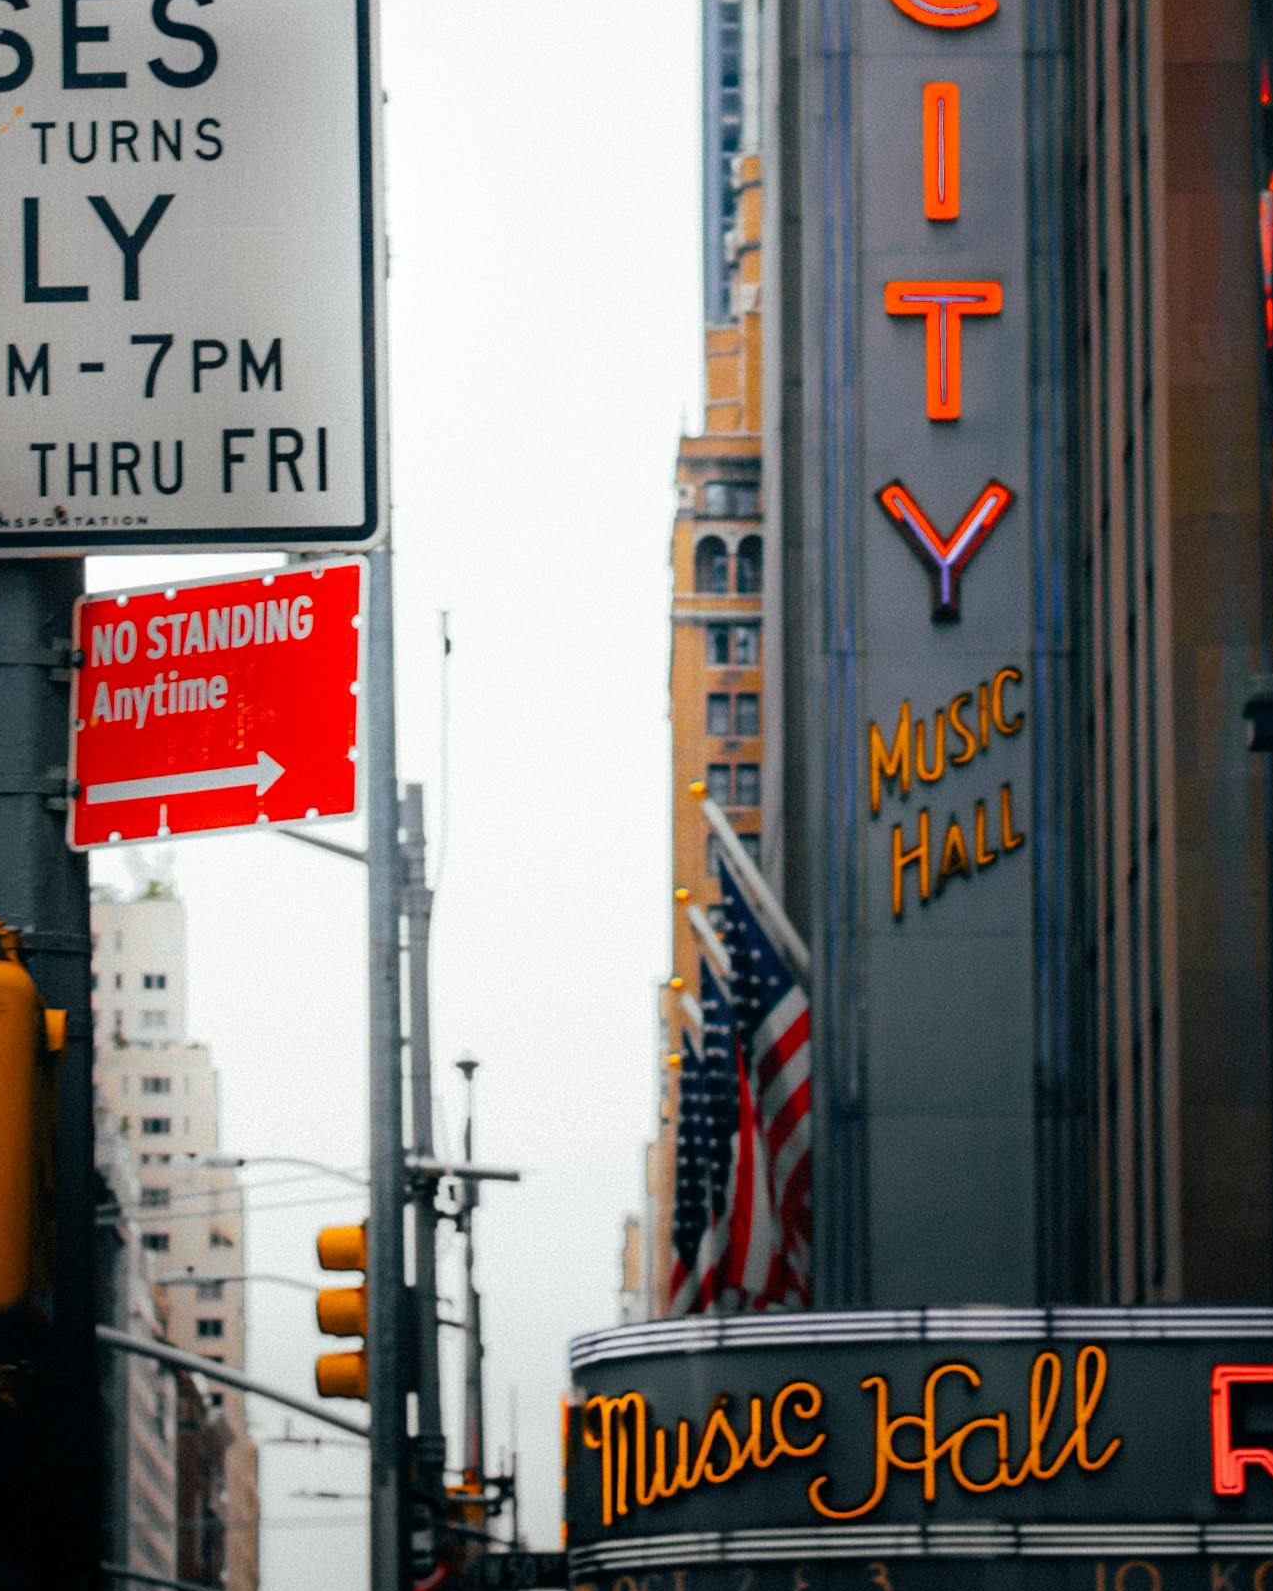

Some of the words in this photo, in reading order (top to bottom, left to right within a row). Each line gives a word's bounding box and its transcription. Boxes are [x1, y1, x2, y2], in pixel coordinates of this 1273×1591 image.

[31, 116, 225, 165] TURNS
[30, 440, 185, 498] THRU
[221, 426, 328, 493] FRI
[91, 620, 138, 667] NO
[146, 595, 314, 660] STANDING
[91, 670, 228, 730] Anytime
[584, 1380, 827, 1526] Music
[808, 1345, 1122, 1520] Hall
